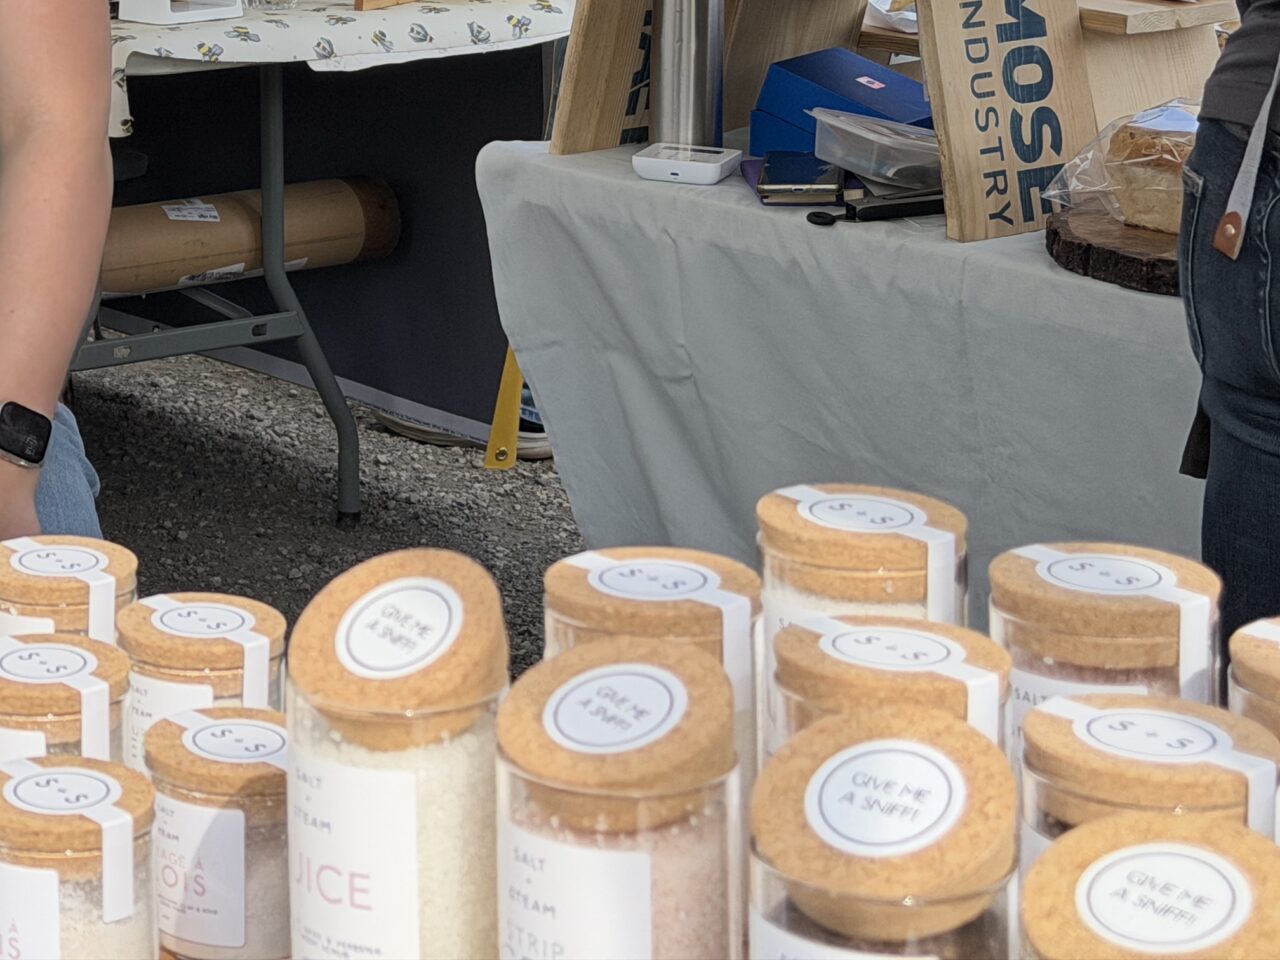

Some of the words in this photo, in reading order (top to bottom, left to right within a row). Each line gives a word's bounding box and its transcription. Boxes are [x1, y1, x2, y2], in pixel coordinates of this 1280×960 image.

[838, 791, 854, 804] A
[851, 771, 899, 789] GIVE
[898, 784, 932, 804] ME
[1110, 887, 1128, 903] A
[1126, 869, 1177, 895] GIVE
[1176, 889, 1214, 909] ME
